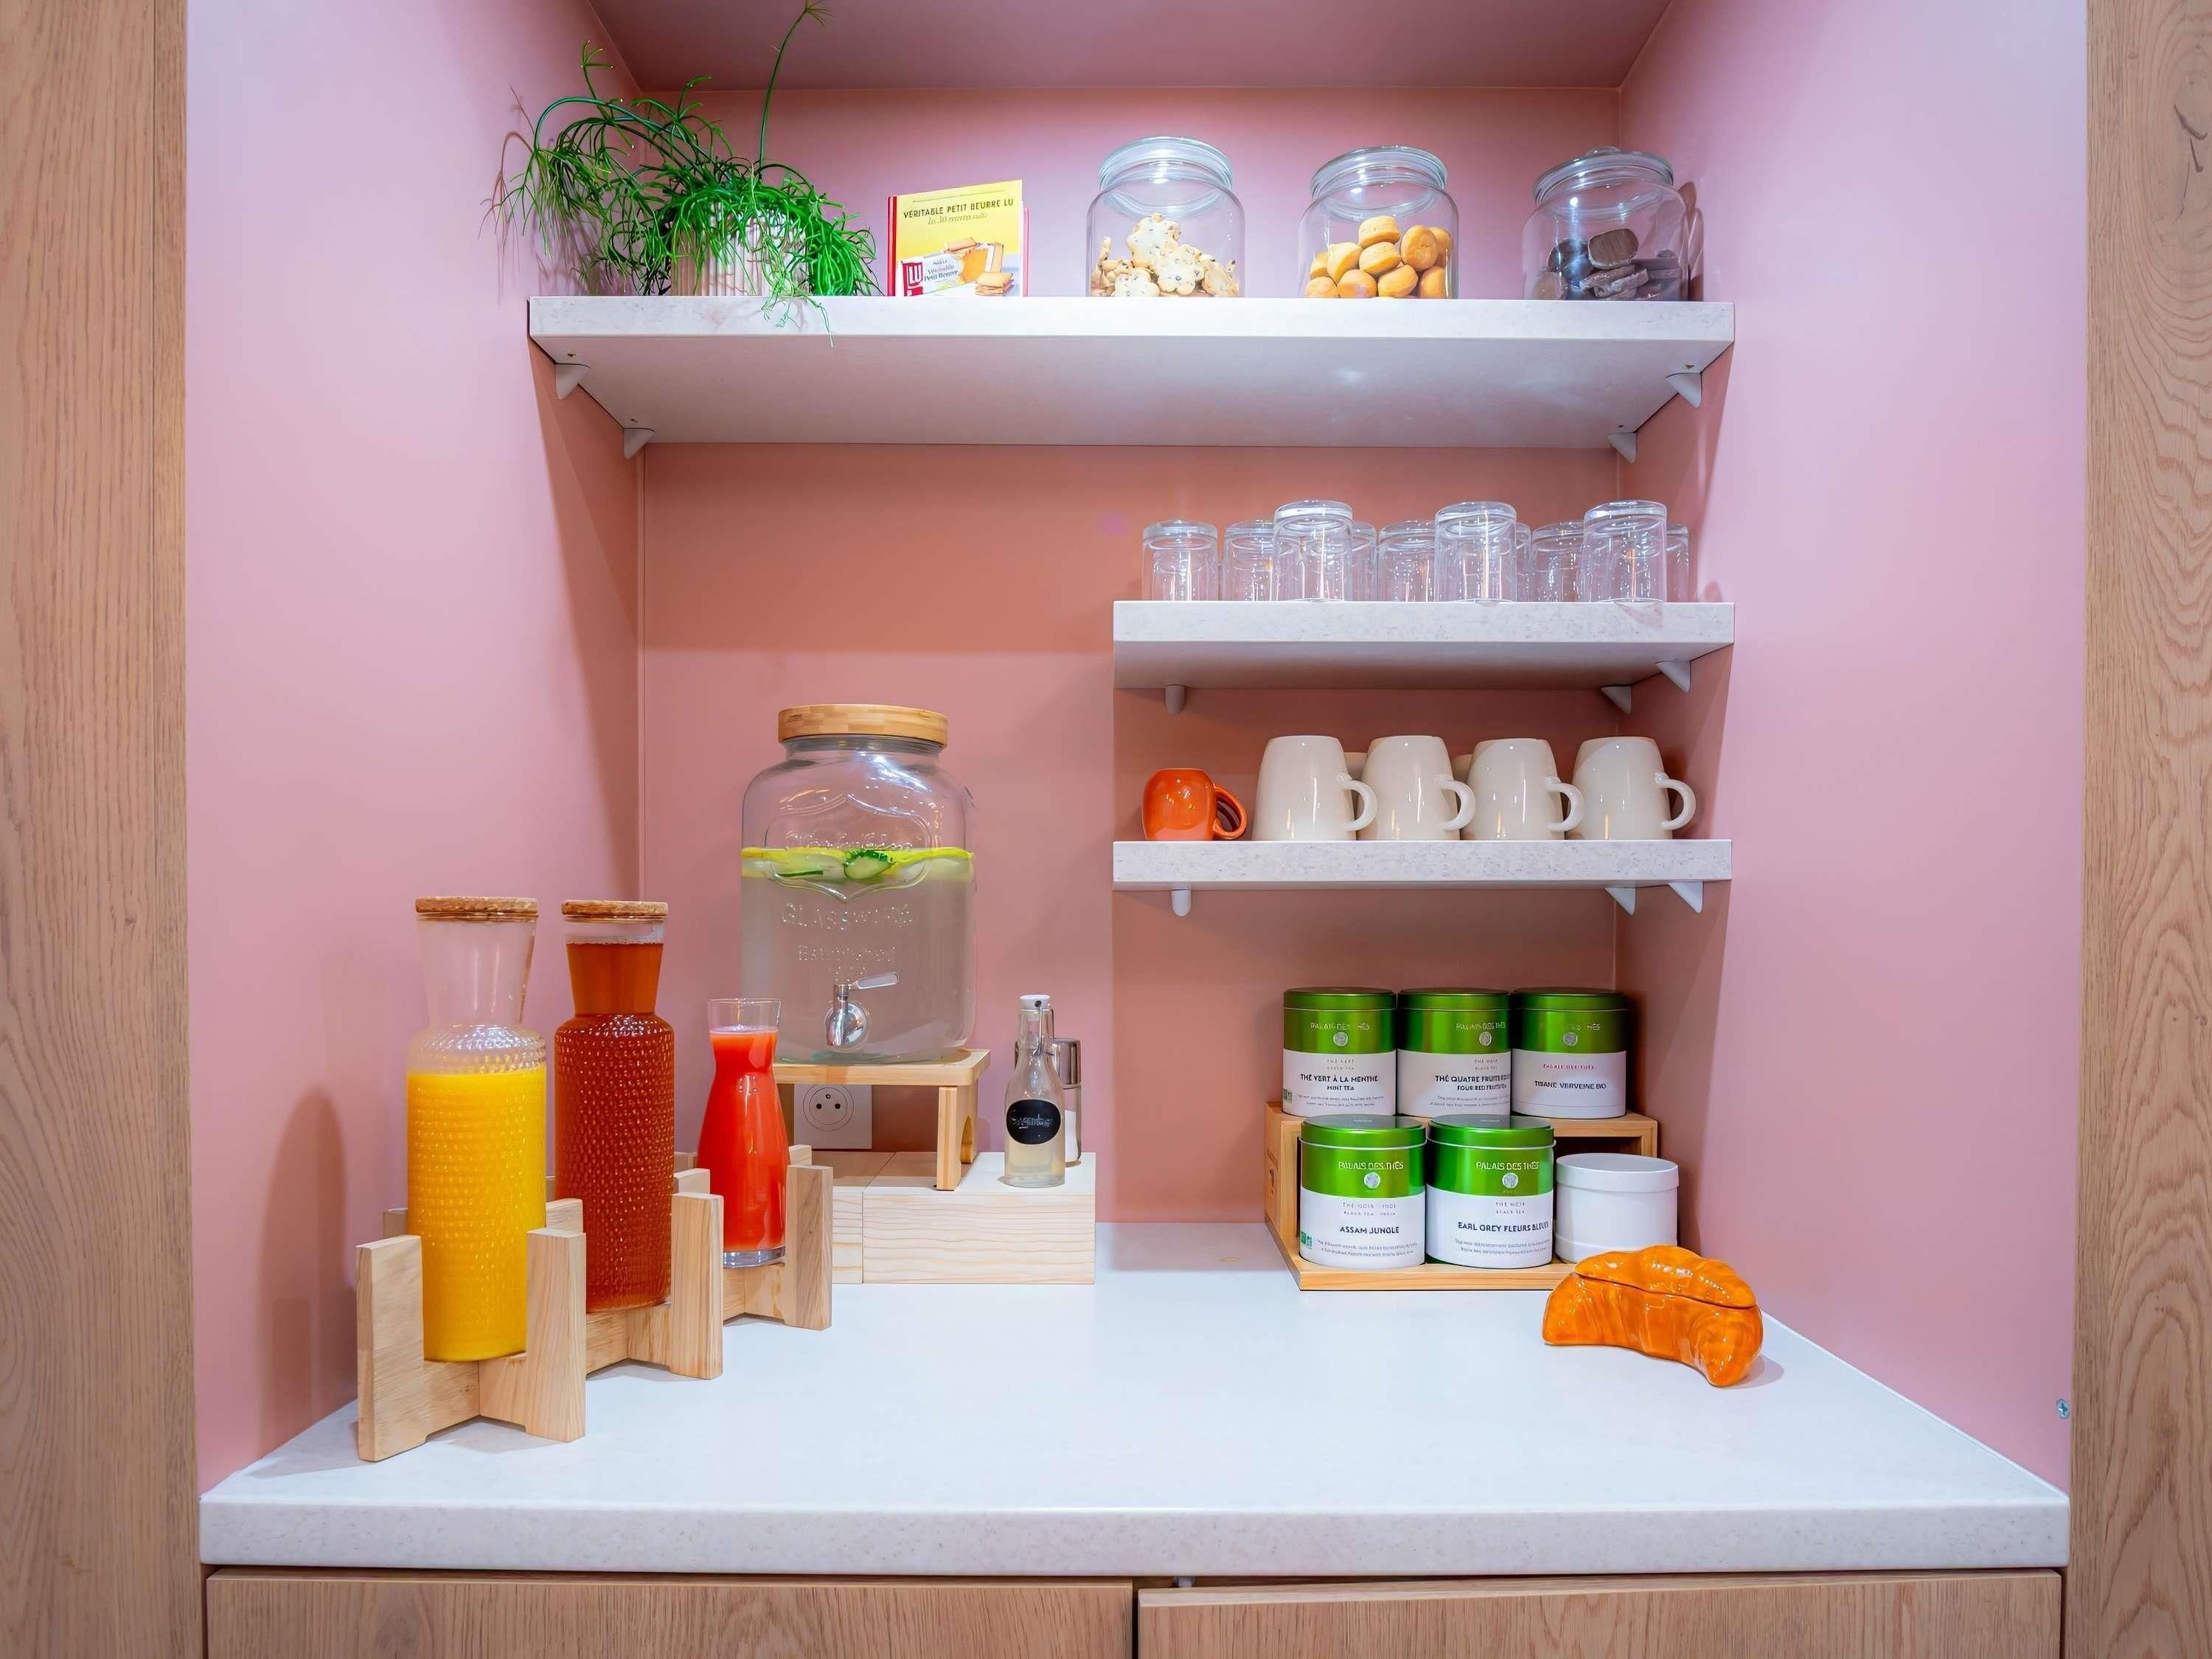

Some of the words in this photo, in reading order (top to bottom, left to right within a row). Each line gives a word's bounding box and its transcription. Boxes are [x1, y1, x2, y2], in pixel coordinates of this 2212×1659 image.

[903, 206, 943, 218] VÉRITABLE
[947, 204, 967, 213] PETIT
[970, 200, 1001, 210] BEURRE
[1004, 198, 1014, 206] LU
[908, 265, 922, 285] LU
[1301, 1073, 1312, 1081] THÉ
[1332, 1074, 1338, 1082] À
[1338, 1161, 1366, 1169] PALAIS
[1368, 1162, 1384, 1170] DES
[1476, 1161, 1505, 1170] PALAIS
[1506, 1162, 1522, 1170] DES
[1523, 1161, 1539, 1169] THÉS
[1340, 1226, 1366, 1234] ASSAM
[1369, 1226, 1399, 1234] JUNGLE
[1458, 1222, 1477, 1231] EARL
